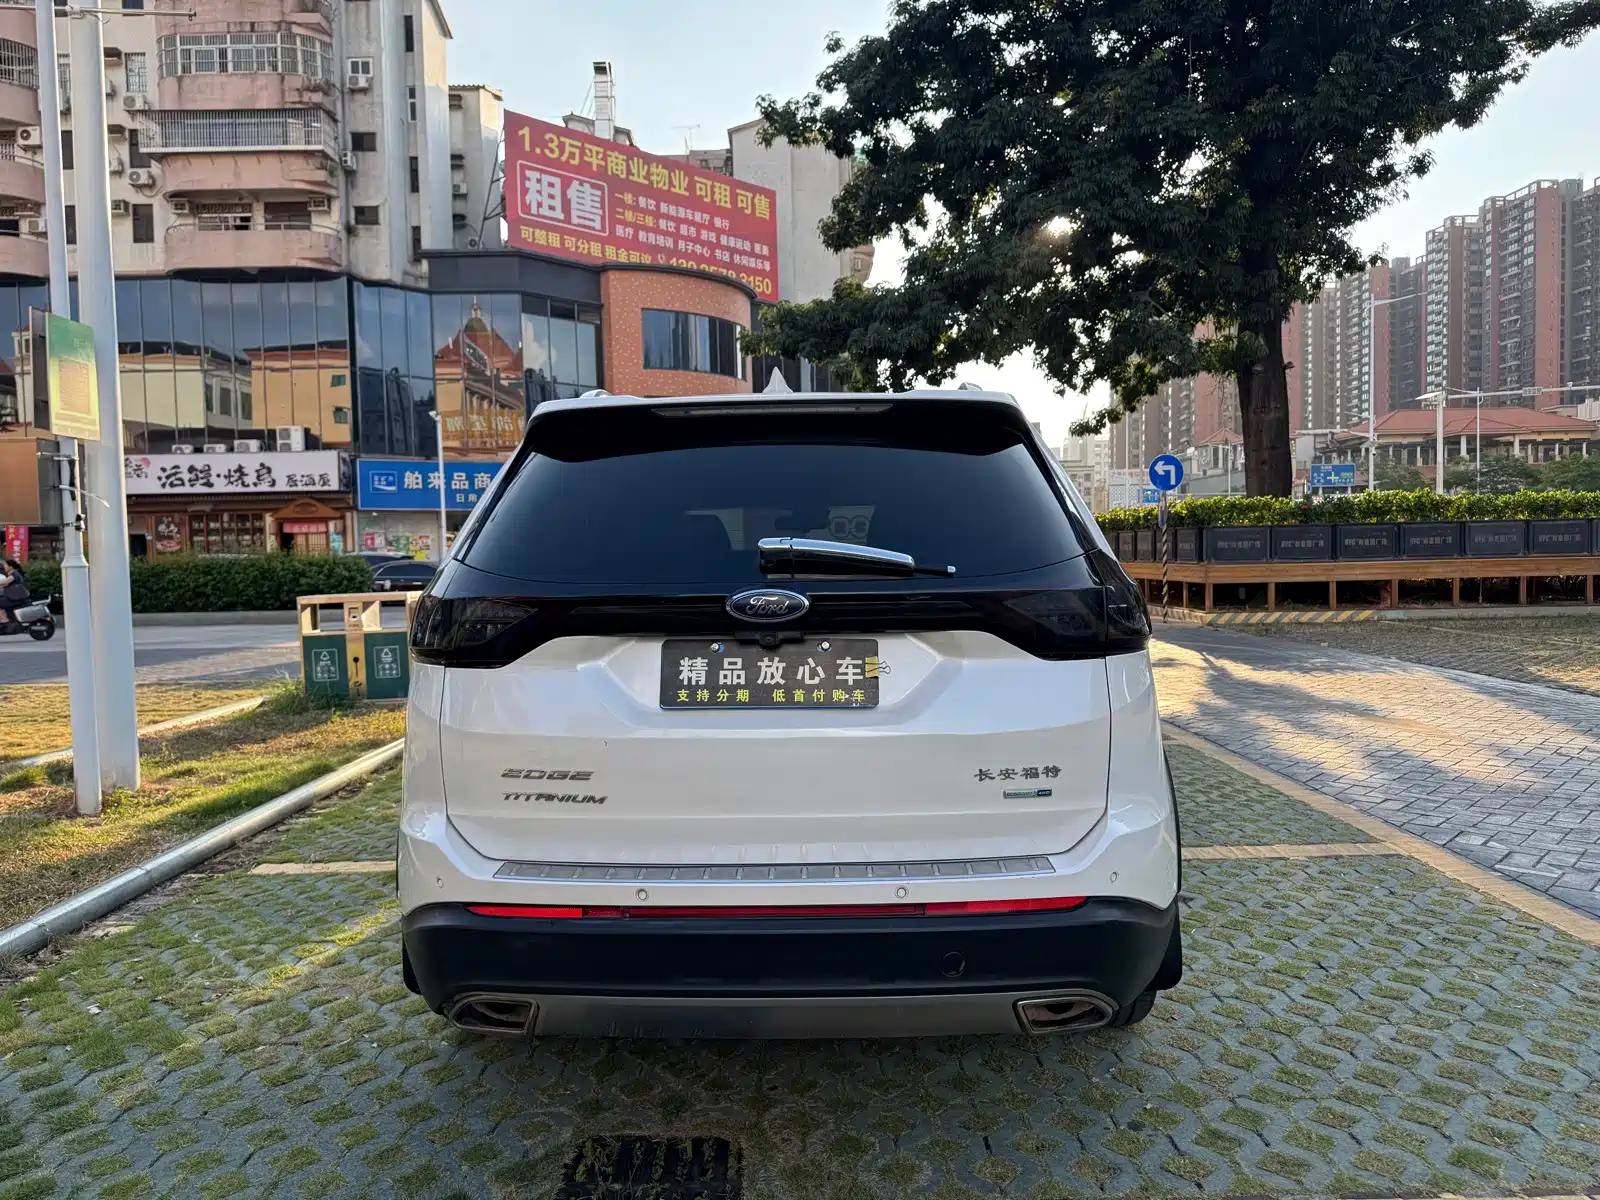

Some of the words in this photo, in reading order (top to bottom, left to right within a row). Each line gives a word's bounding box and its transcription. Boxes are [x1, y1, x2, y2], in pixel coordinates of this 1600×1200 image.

[518, 126, 689, 196] 1.3万平商业物业
[694, 176, 731, 208] 可租
[736, 189, 770, 220] 可售
[525, 169, 602, 230] 租售
[639, 196, 656, 211] 餐饮
[714, 216, 730, 230] 银行
[520, 225, 560, 248] 可整租
[564, 236, 601, 257] 可分租
[659, 218, 676, 232] 餐饮
[680, 224, 696, 238] 超市
[701, 229, 716, 243] 游戏
[720, 234, 751, 252] 健康运动
[616, 224, 633, 239] 医疗
[639, 230, 673, 249] 教育培训
[678, 240, 710, 257] 月子中心
[715, 248, 730, 263] 书店
[733, 253, 770, 272] 休闲娱乐等
[285, 473, 331, 487] 居酒屋
[404, 471, 491, 490] 舶来品商
[746, 596, 789, 615] Ford
[679, 657, 864, 685] 精品放心车
[677, 689, 749, 702] 支持分期
[773, 689, 865, 702] 低首付购车
[501, 768, 594, 781] EDGE
[974, 765, 1062, 782] 长安福特
[502, 792, 608, 805] TITANIUM
